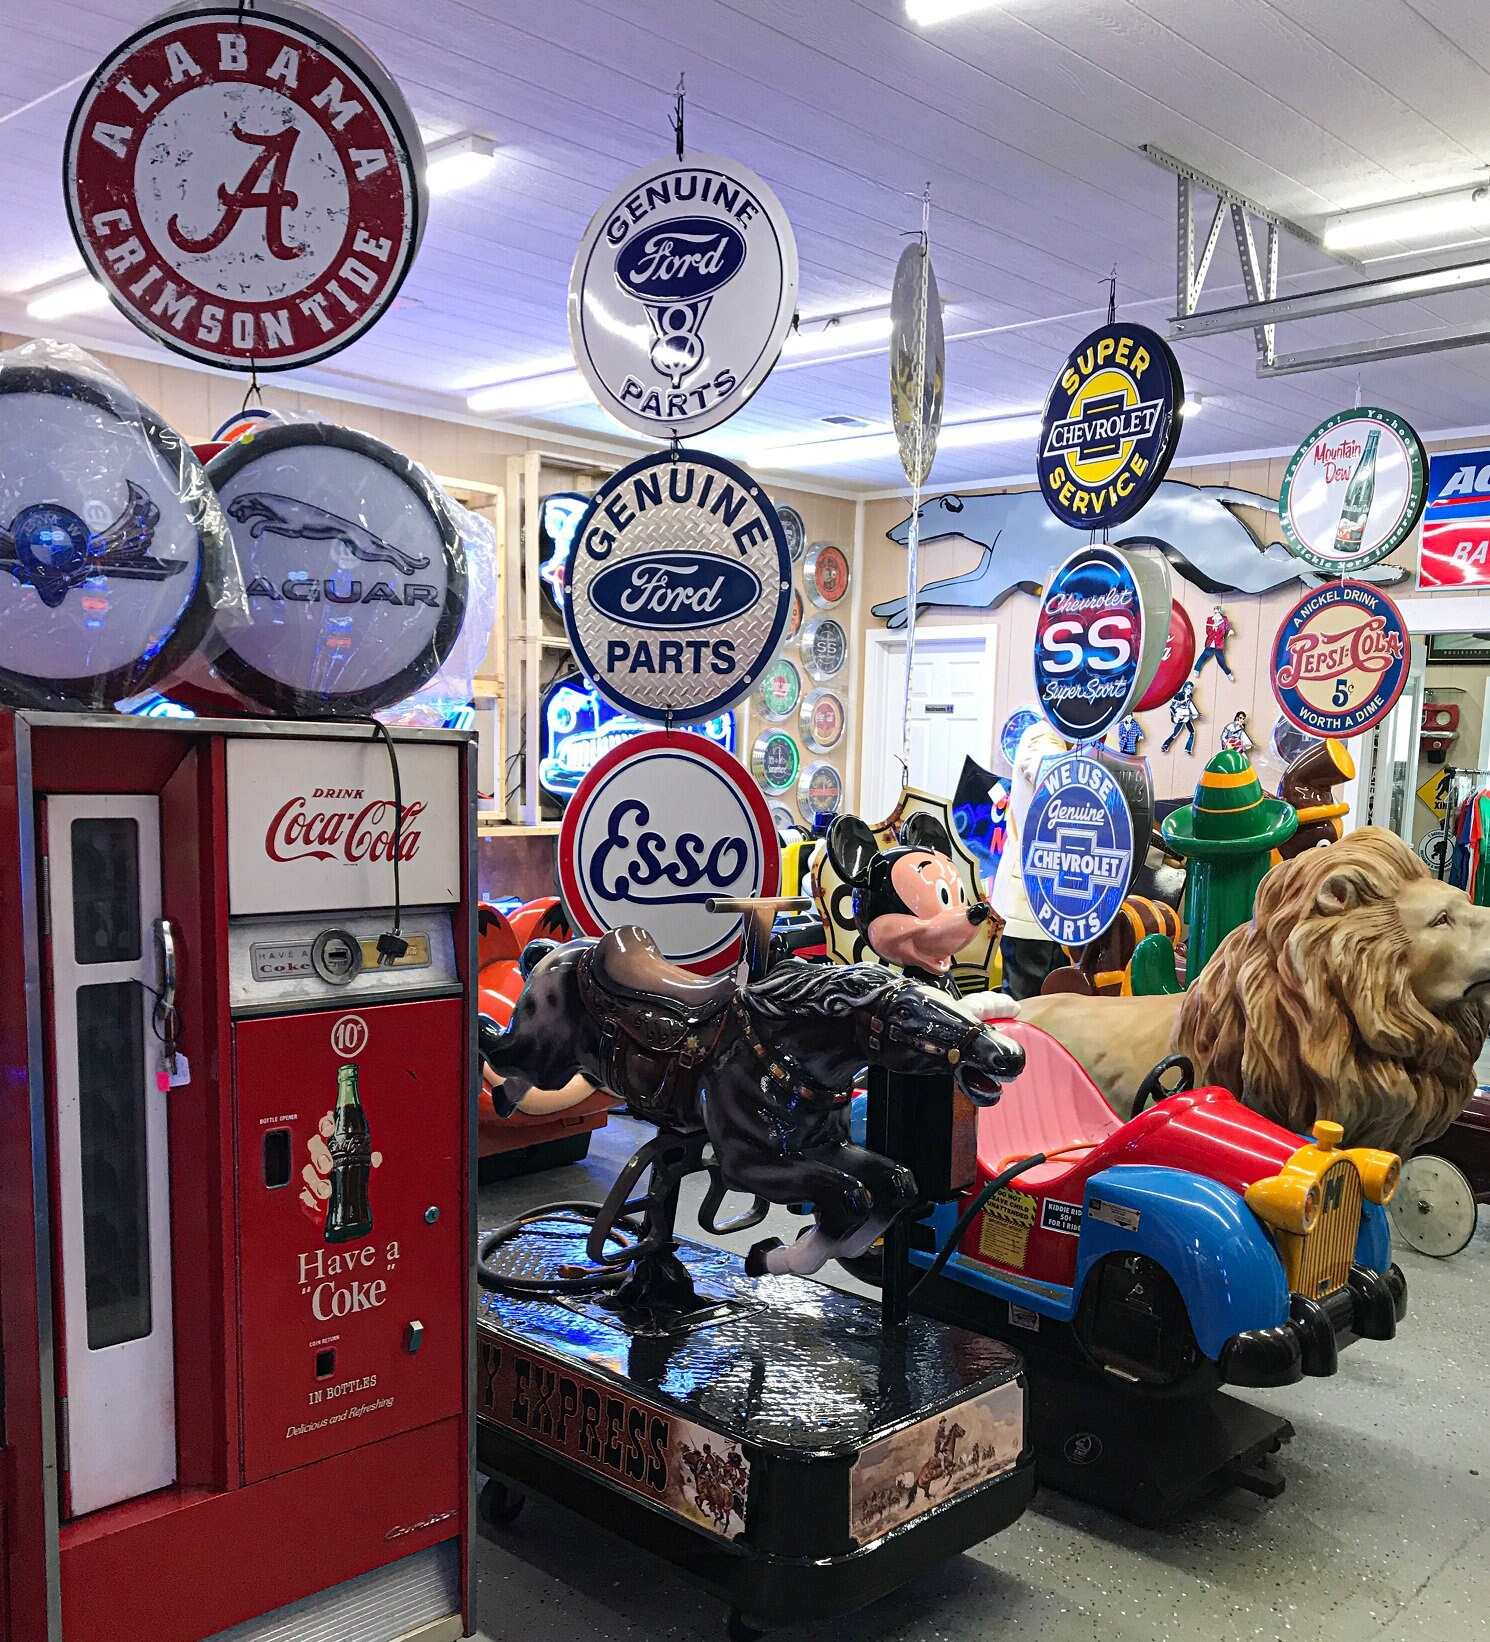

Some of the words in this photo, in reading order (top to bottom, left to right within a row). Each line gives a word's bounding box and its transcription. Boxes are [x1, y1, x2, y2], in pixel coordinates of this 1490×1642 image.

[92, 33, 390, 181] ALABAMA
[167, 121, 302, 261] A
[606, 175, 759, 247] GENUINE
[629, 232, 730, 284] Ford
[94, 209, 294, 350] CRIMSON
[303, 228, 392, 335] TIDE
[1061, 336, 1150, 396] SUPER
[620, 368, 736, 417] PARTS
[1052, 408, 1155, 448] CHEVROLET
[1313, 439, 1361, 465] Mountain
[1049, 452, 1149, 514] SERVICE
[1324, 461, 1352, 484] Dew
[585, 468, 769, 561] GENUINE
[247, 577, 440, 608] AGUAR
[620, 563, 725, 613] Ford
[1045, 587, 1134, 615] Chevrolet
[1293, 617, 1303, 628] A
[1300, 590, 1341, 619] NICKEL
[1343, 589, 1380, 609] DRINK
[606, 639, 737, 675] PARTS
[1042, 615, 1134, 673] SS
[1043, 681, 1084, 708] Super
[1083, 677, 1127, 704] Sport
[1299, 706, 1341, 729] WORTH
[1345, 718, 1354, 728] A
[1356, 694, 1385, 722] DIME
[312, 788, 365, 799] DRINK
[1044, 763, 1072, 795] WE
[1078, 762, 1114, 802] USE
[1047, 799, 1105, 829] Genuine
[1433, 801, 1449, 810] XIN
[265, 796, 428, 862] Coca-Cola
[1033, 850, 1120, 878] CHEVROLET
[1038, 902, 1101, 941] PARTS
[258, 951, 294, 960] HAVE
[301, 950, 309, 958] A
[259, 962, 311, 973] Coke
[259, 1115, 279, 1125] BOTTLE
[279, 1113, 298, 1122] OPENER
[987, 1201, 1029, 1220] UNATTENDED
[992, 1195, 1009, 1206] EAVE
[1009, 1201, 1029, 1213] CHILD
[1008, 1193, 1022, 1203] NOT
[1048, 1202, 1070, 1214] KIDDIE
[1070, 1208, 1083, 1217] RID
[1048, 1218, 1061, 1228] FOR
[1062, 1221, 1066, 1229] 1
[1066, 1222, 1081, 1232] RIDE
[298, 1245, 376, 1285] Have
[386, 1240, 400, 1260] a
[309, 1339, 322, 1348] COIN
[322, 1335, 340, 1345] RETURN
[308, 1390, 323, 1405] IN
[326, 1375, 377, 1401] BOTTLES
[286, 1416, 328, 1439] Delicious
[329, 1409, 348, 1425] and
[348, 1396, 395, 1420] Refreshing
[511, 1355, 671, 1493] EXPRESS
